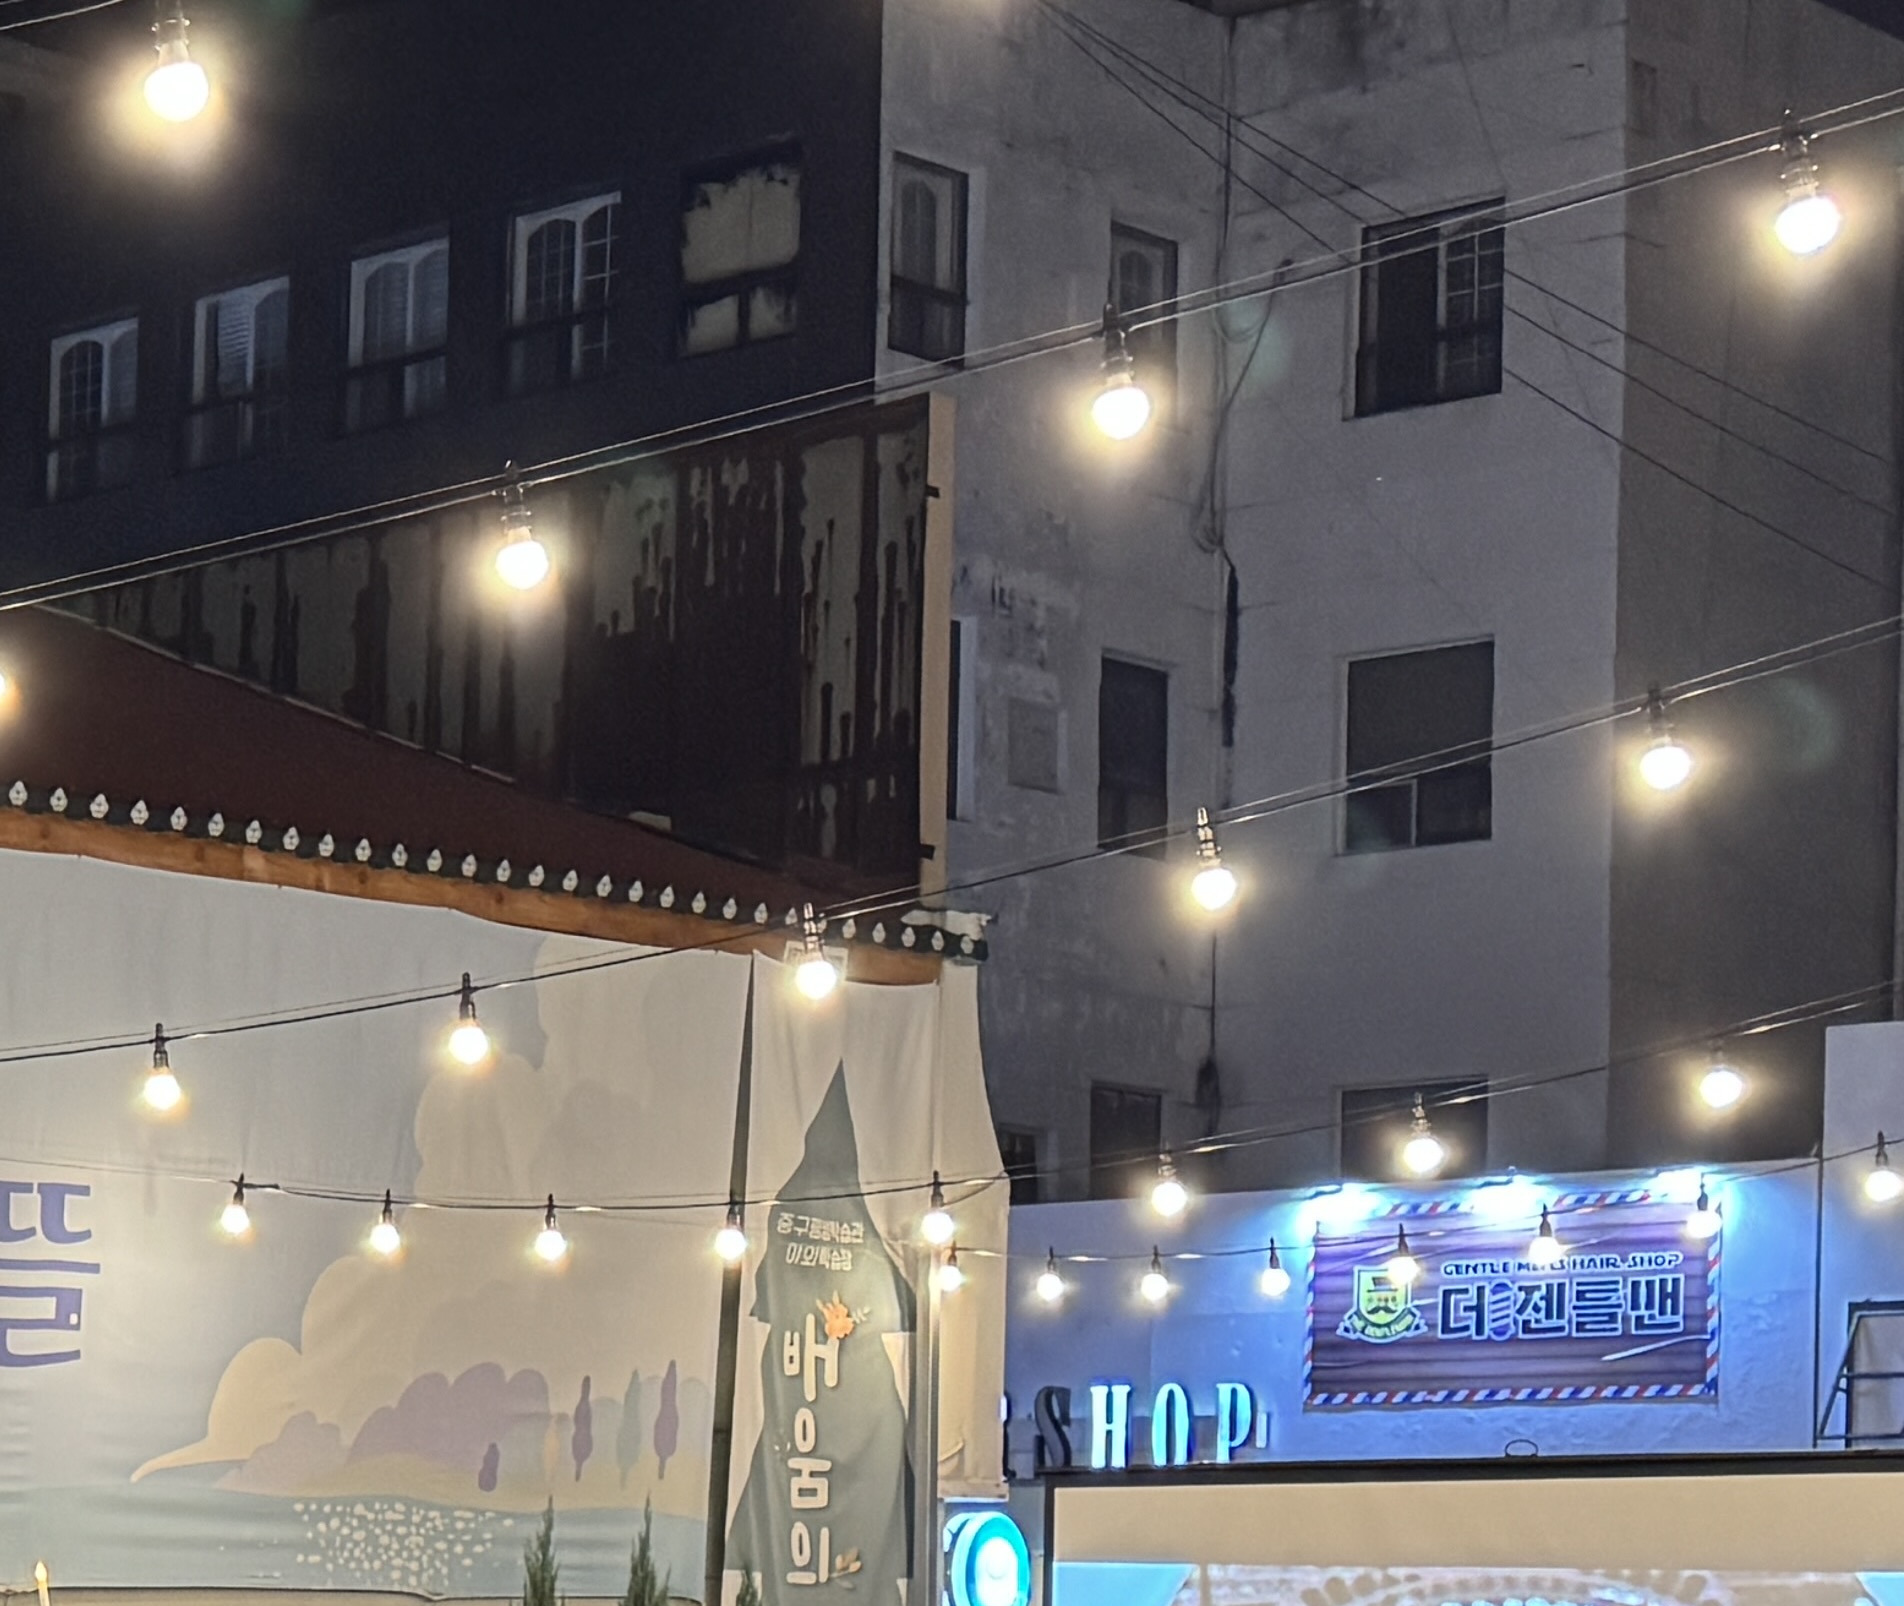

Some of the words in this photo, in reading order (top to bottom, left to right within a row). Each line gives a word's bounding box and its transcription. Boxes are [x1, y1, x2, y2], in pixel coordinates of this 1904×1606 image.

[1443, 1261, 1510, 1276] GENTLE
[1571, 1254, 1621, 1271] HAIR
[1626, 1252, 1681, 1268] SHOP
[1034, 1382, 1252, 1470] SHOP
